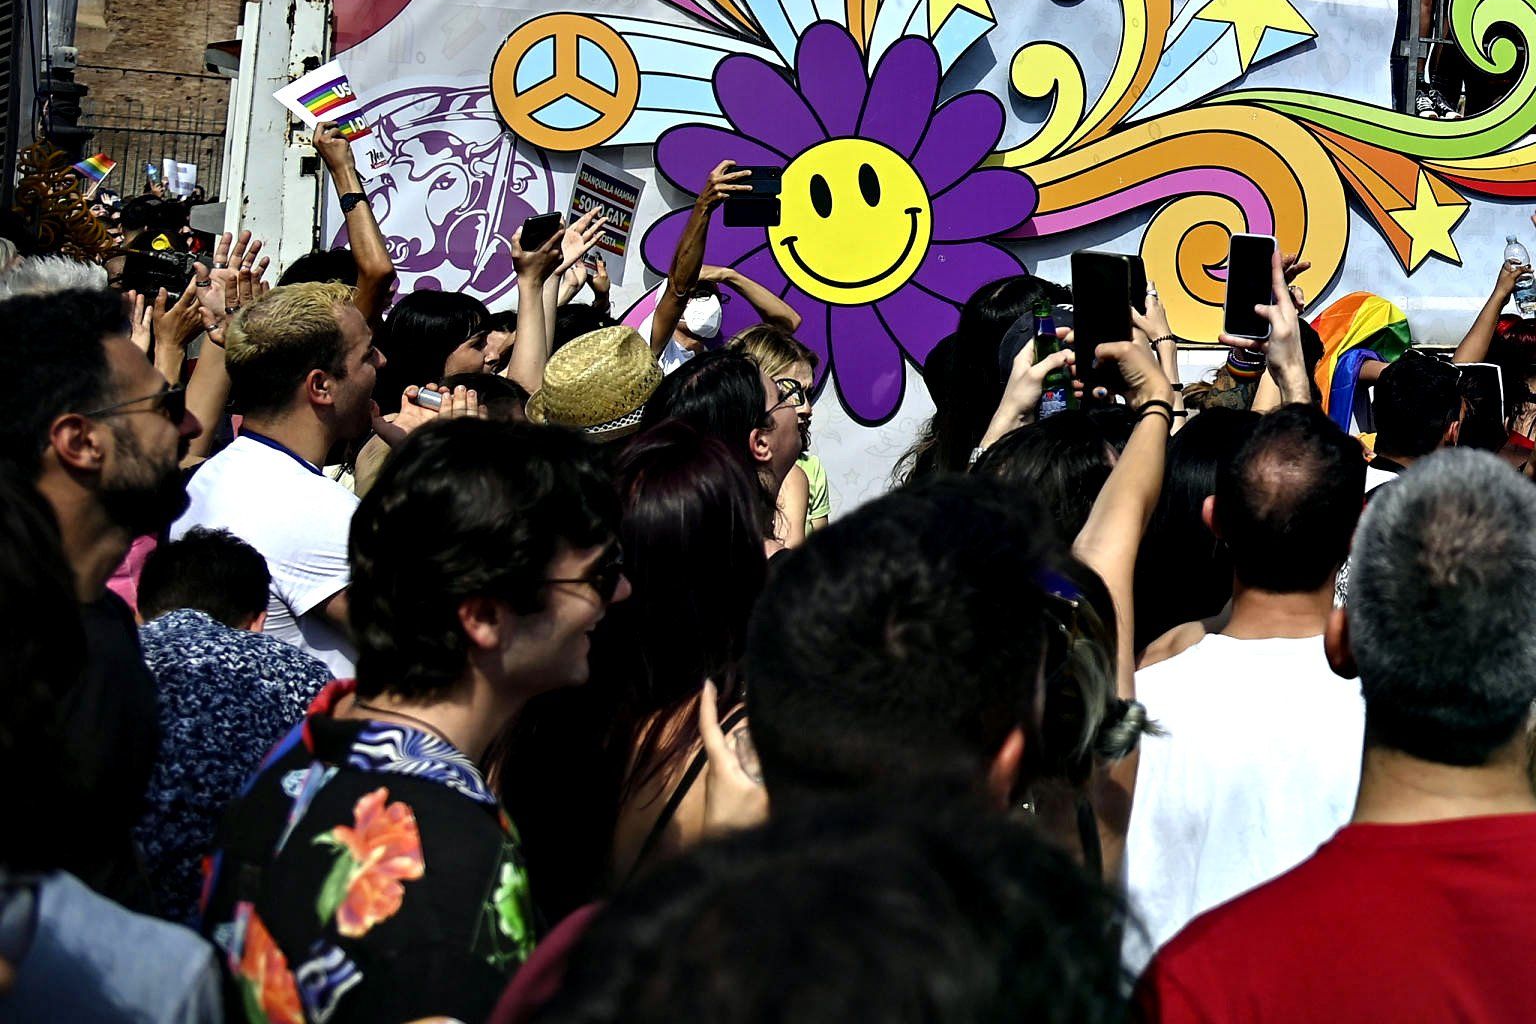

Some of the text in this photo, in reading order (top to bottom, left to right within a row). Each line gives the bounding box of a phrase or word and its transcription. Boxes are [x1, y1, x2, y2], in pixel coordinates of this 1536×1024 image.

[581, 171, 636, 205] TRANQUILLA MAMMA
[606, 207, 627, 227] GAY
